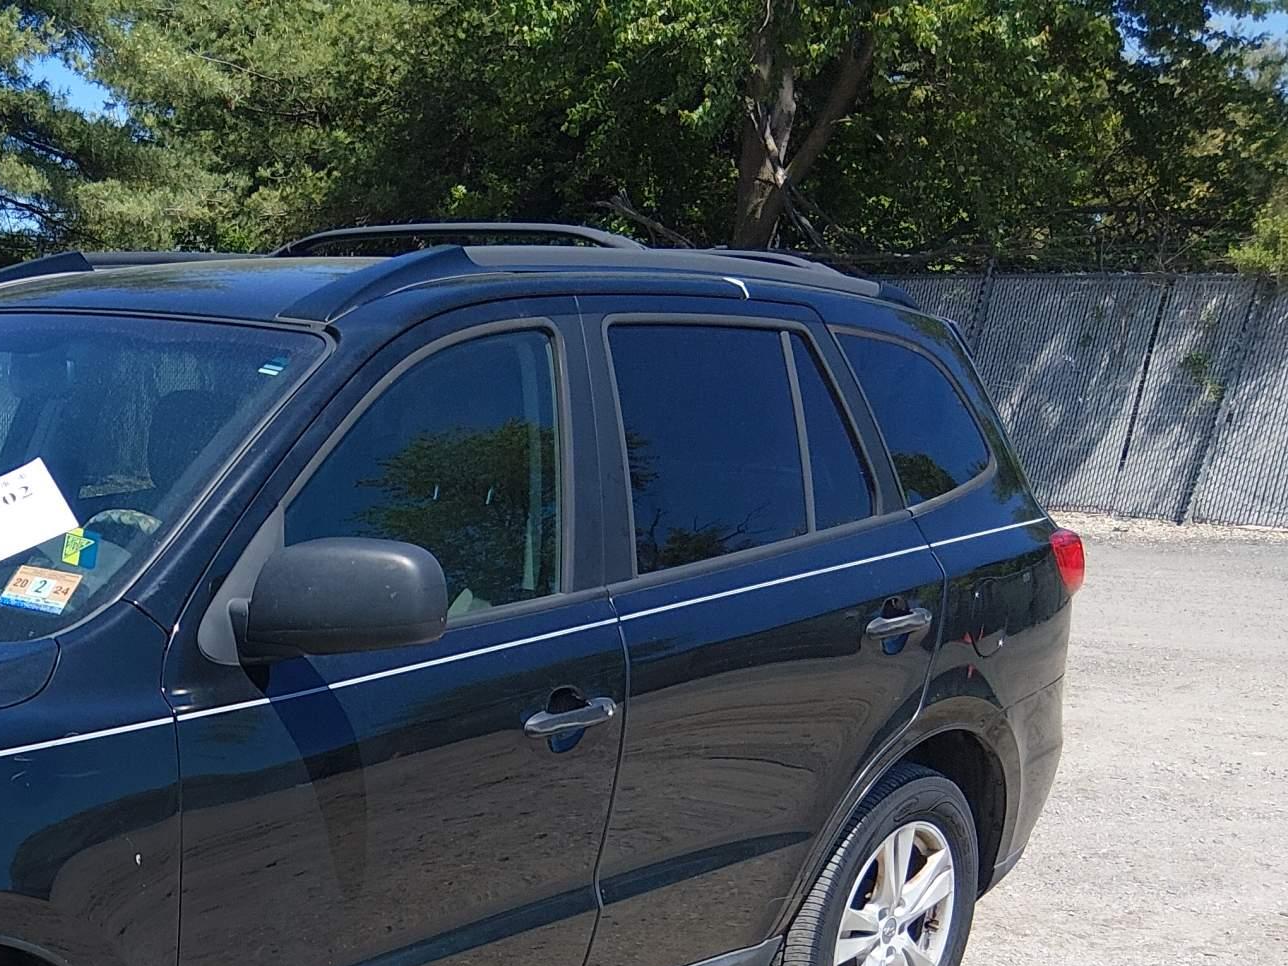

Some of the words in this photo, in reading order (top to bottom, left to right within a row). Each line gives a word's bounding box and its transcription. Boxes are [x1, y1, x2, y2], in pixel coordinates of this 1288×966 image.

[13, 577, 29, 588] 20
[35, 579, 48, 594] 2
[53, 585, 70, 597] 24
